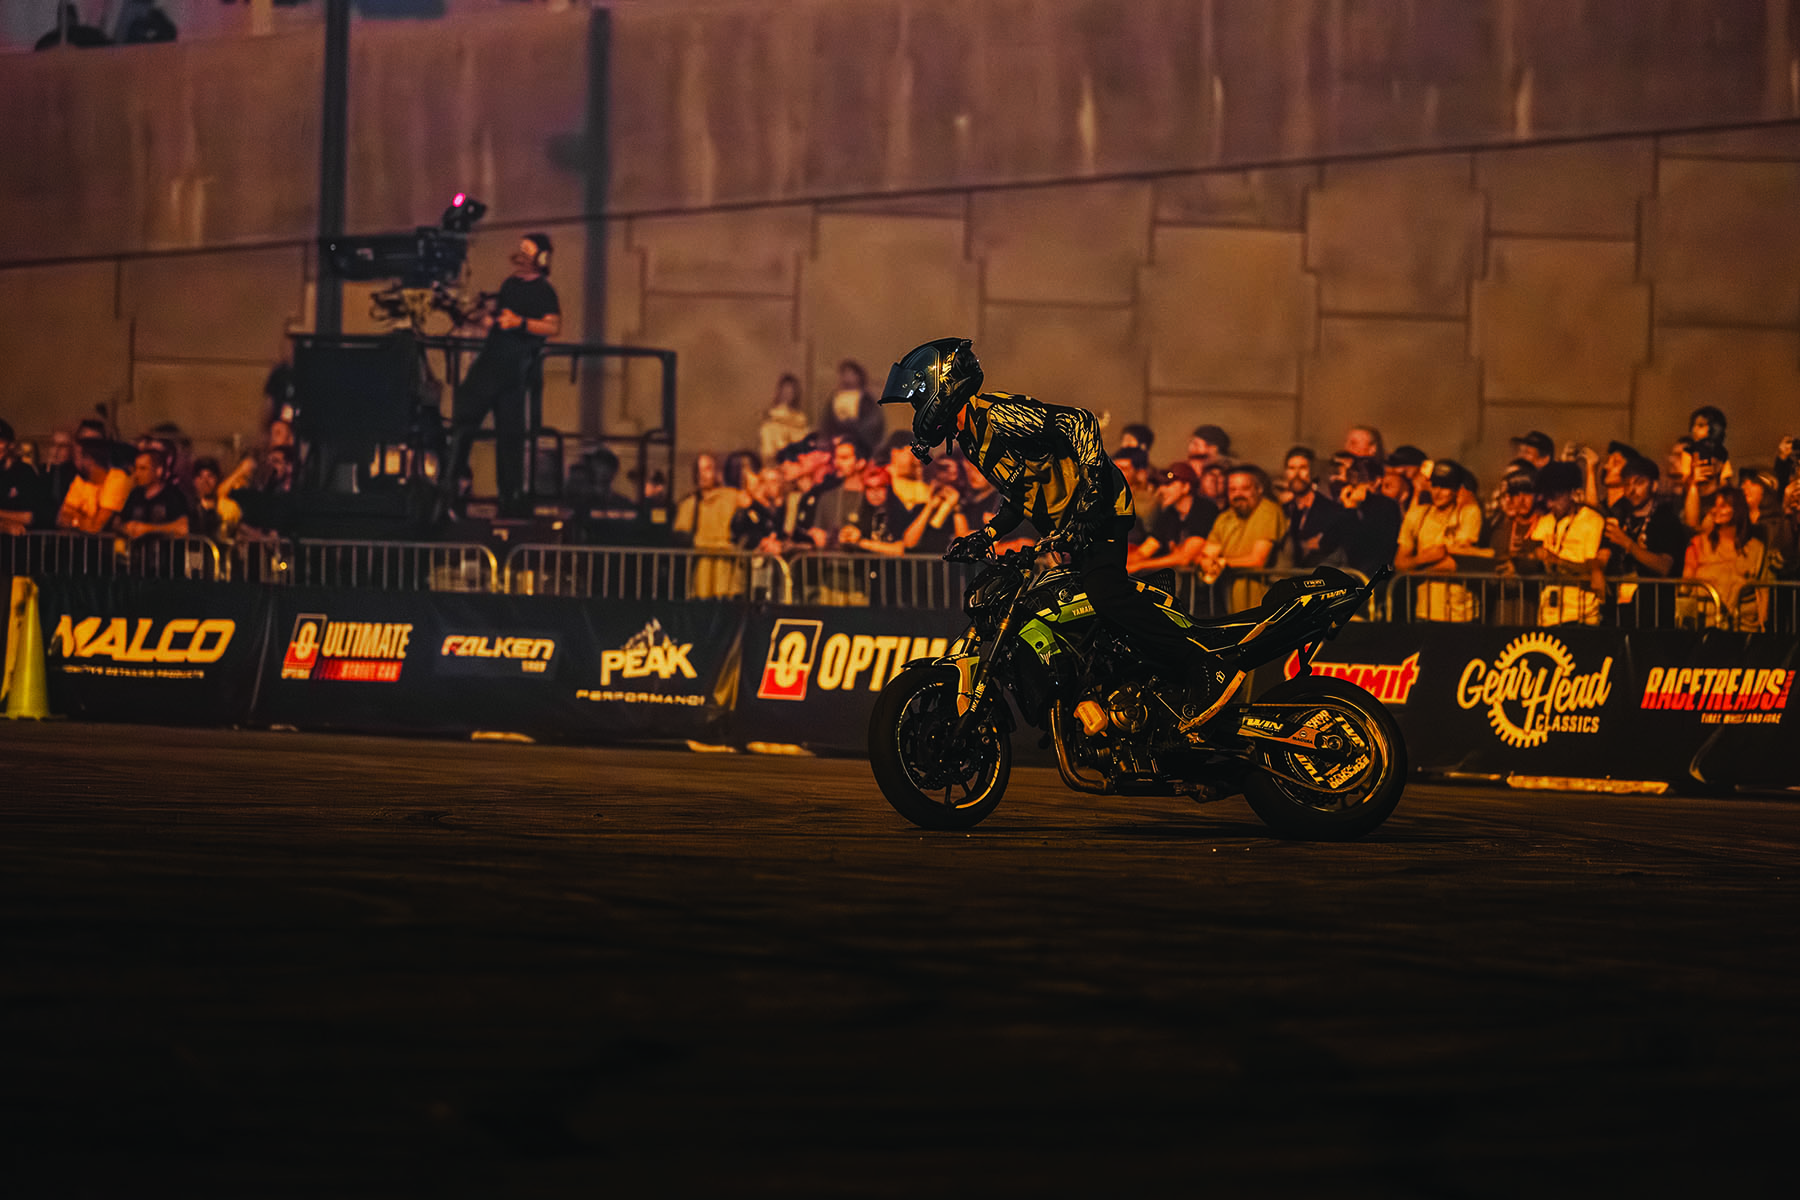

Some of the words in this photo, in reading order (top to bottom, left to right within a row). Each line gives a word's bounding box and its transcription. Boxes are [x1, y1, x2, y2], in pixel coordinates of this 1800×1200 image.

[1071, 604, 1095, 617] YAMAH
[1319, 588, 1348, 601] TWIN
[48, 614, 236, 663] MALCO
[321, 621, 414, 660] ULTIMATE
[441, 635, 556, 660] FALKEN
[600, 642, 698, 687] PEAK
[817, 633, 966, 692] OPTI
[1456, 657, 1536, 710] Gear
[1521, 655, 1614, 735] Head
[1640, 667, 1787, 711] RACETREADS
[1535, 714, 1600, 733] CLASSICS
